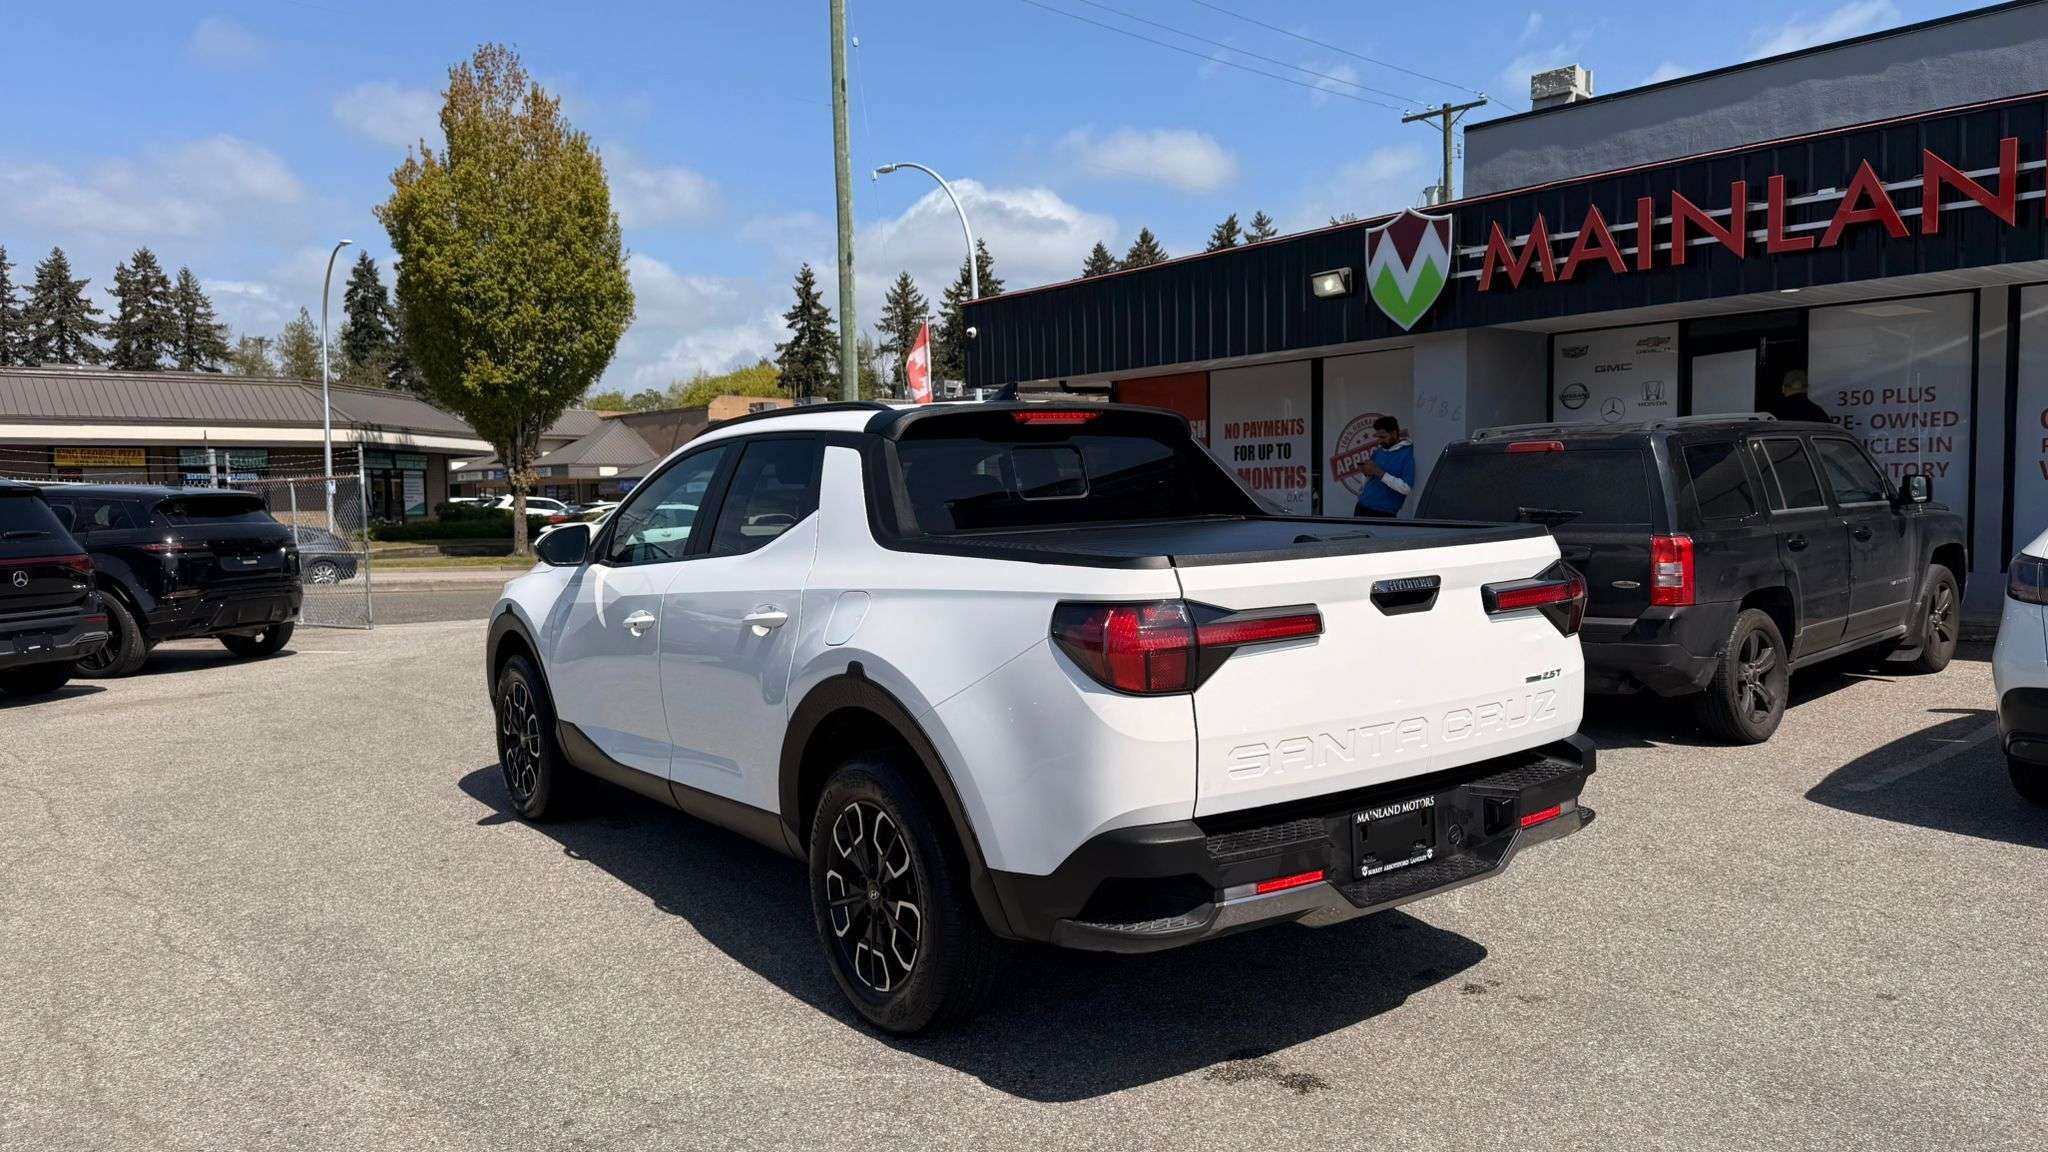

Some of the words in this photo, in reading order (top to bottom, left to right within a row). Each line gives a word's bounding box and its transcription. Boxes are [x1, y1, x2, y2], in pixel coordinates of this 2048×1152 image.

[1478, 130, 2048, 292] MAINLAN
[1594, 362, 1632, 374] GMC
[1637, 400, 1668, 408] HONDA
[1838, 389, 1874, 406] 350
[1882, 386, 1936, 404] PLUS
[1224, 422, 1240, 440] NO
[1243, 418, 1305, 438] PAYMENTS
[1871, 411, 1960, 430] OWNED
[1234, 445, 1255, 461] FOR
[1259, 444, 1273, 461] UP
[1275, 443, 1292, 459] TO
[1928, 436, 1953, 452] IN
[1389, 577, 1433, 592] HYUNDAI
[1226, 717, 1429, 780] SANTA
[1441, 689, 1558, 744] CRUZ
[1356, 804, 1401, 823] MAINLAND
[1401, 796, 1435, 812] MOTORS
